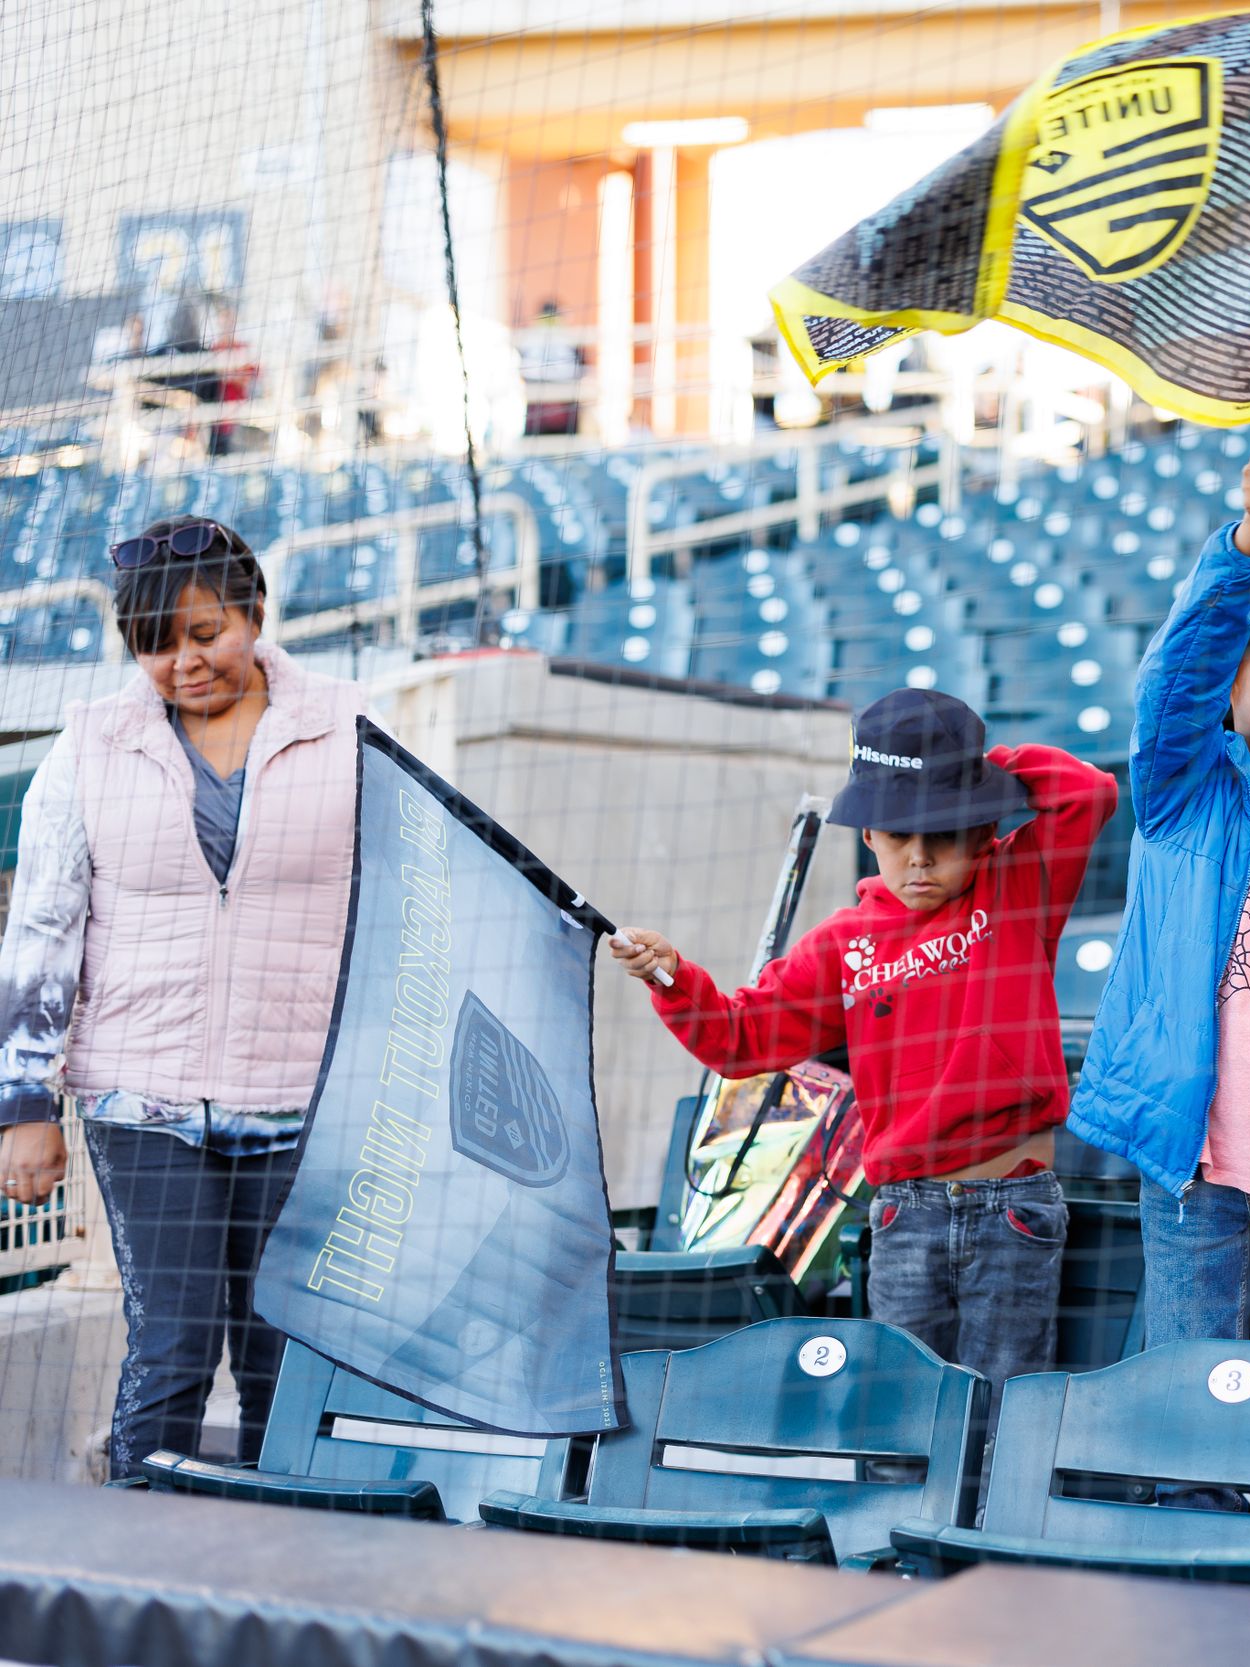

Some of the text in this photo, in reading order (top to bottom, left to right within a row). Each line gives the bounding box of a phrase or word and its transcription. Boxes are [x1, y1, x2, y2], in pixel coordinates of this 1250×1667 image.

[854, 744, 924, 770] Hisense
[814, 1346, 830, 1366] 2
[1226, 1370, 1242, 1391] 3
